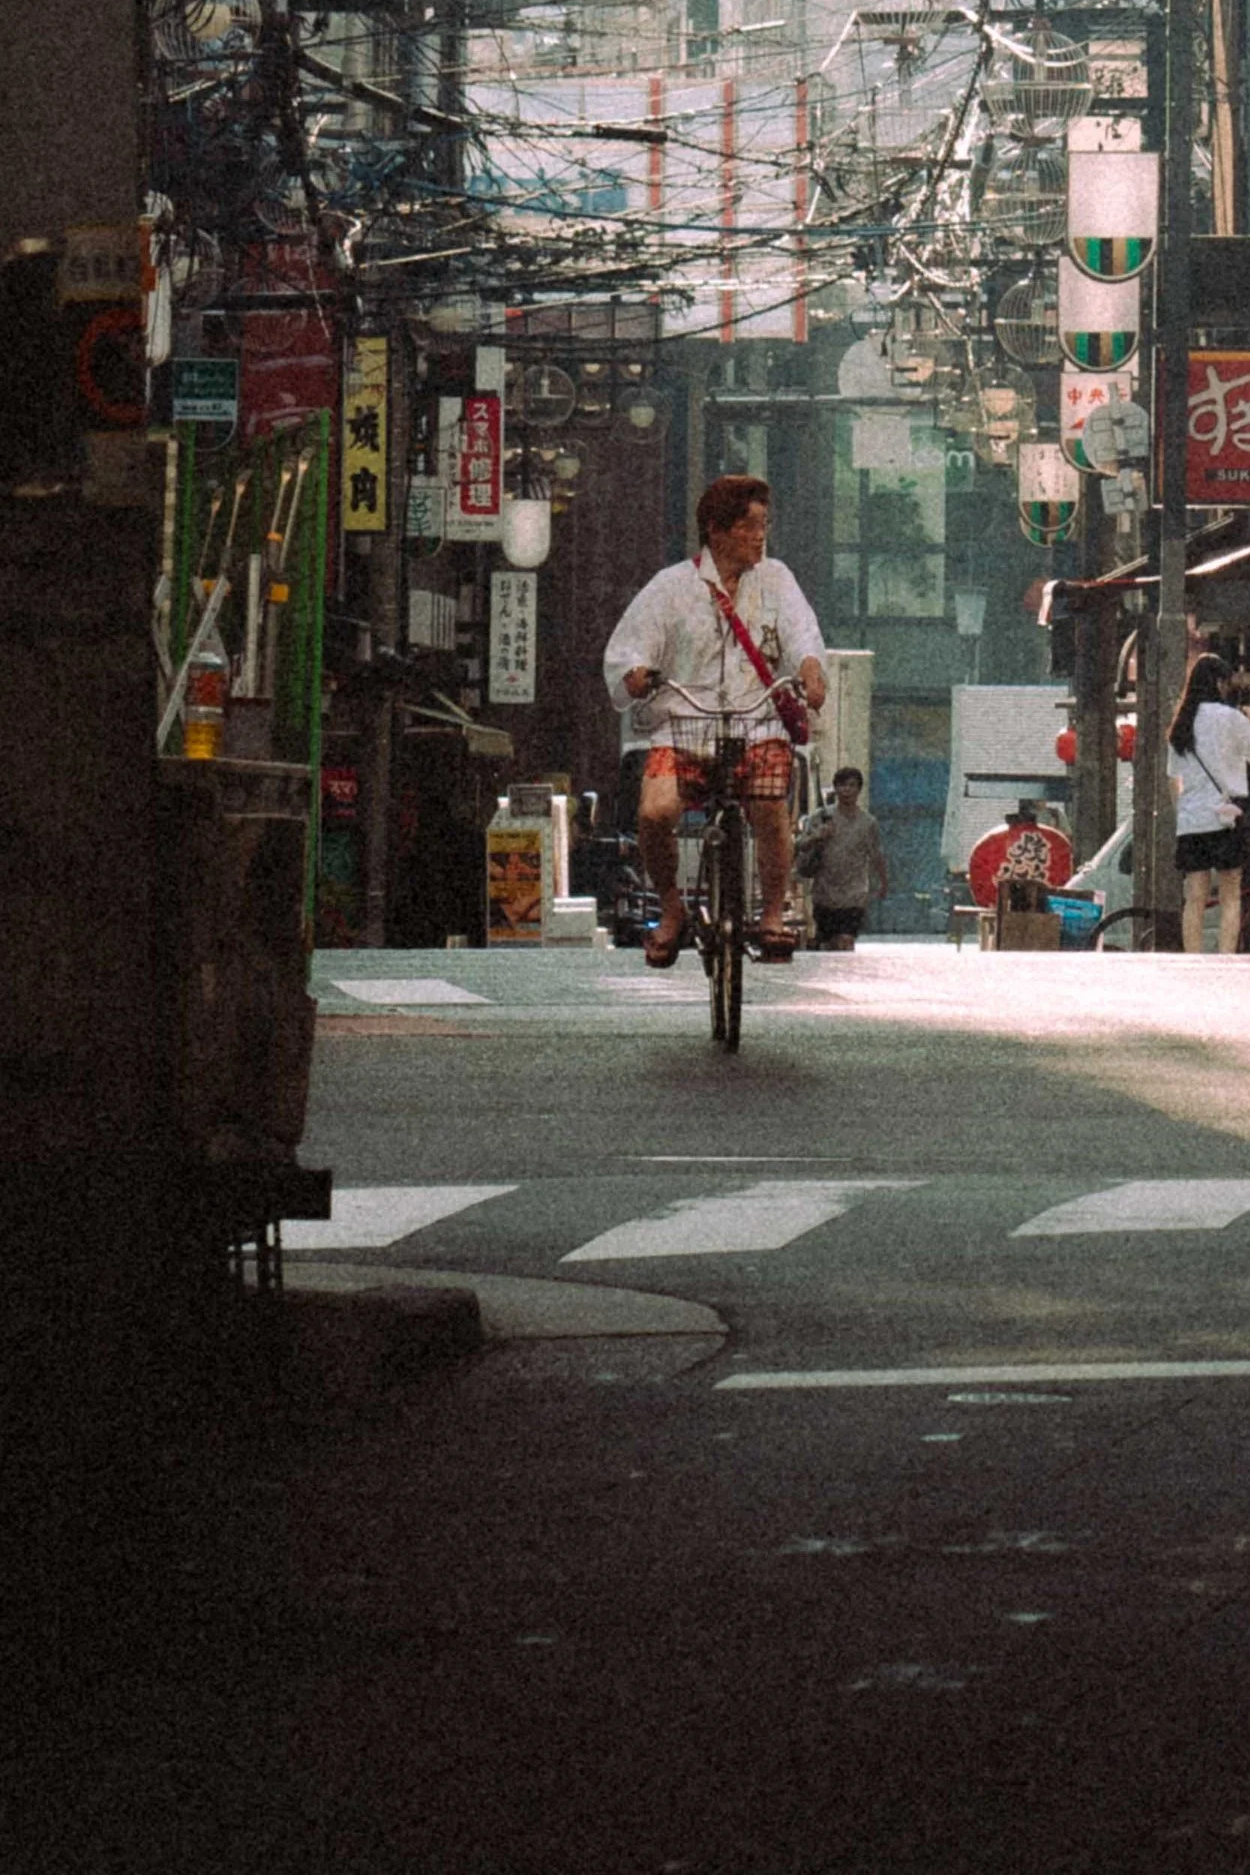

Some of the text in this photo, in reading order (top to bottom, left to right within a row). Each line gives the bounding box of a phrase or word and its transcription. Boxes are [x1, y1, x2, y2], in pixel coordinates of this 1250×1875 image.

[1066, 388, 1129, 406] 中央
[346, 404, 381, 514] 焼肉
[467, 402, 493, 509] スマホ修理
